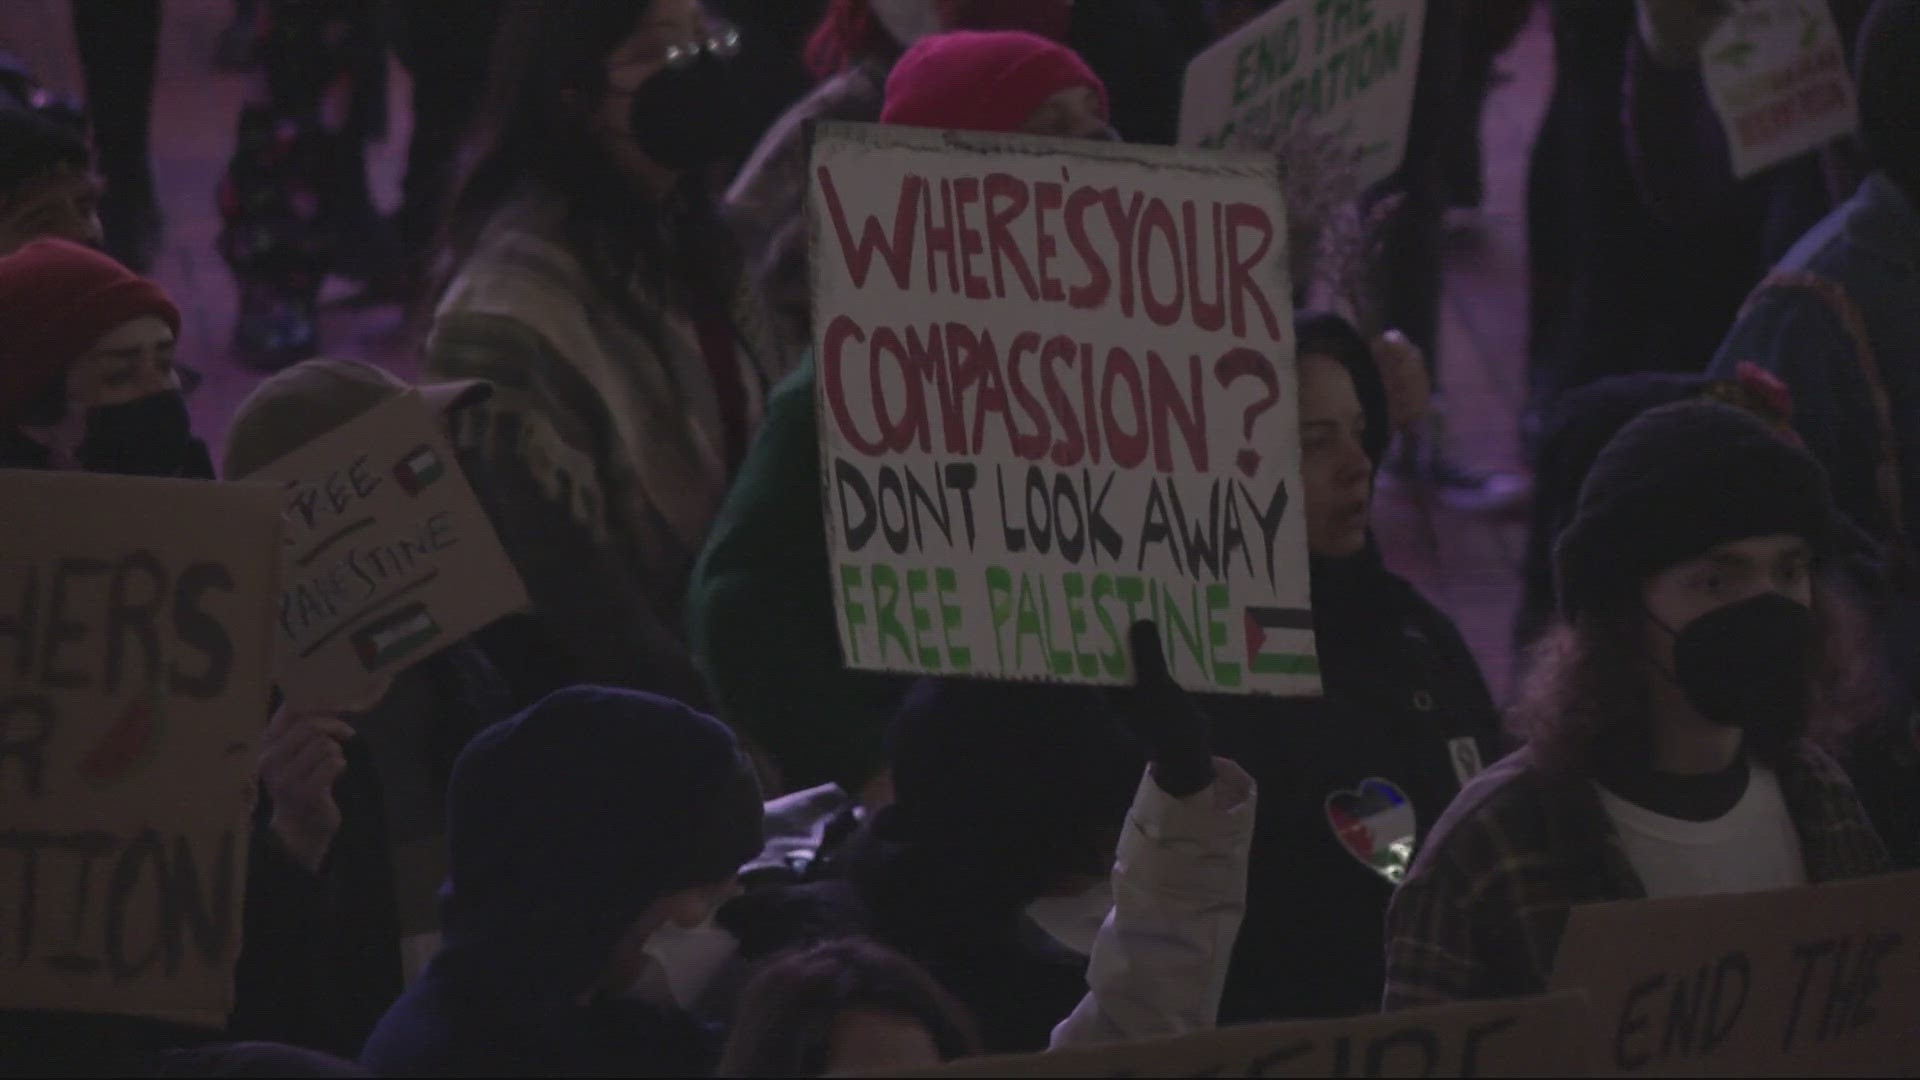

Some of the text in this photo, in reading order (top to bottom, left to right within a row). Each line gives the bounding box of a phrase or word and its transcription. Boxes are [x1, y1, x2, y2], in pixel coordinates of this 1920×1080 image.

[1232, 16, 1298, 106] END
[1101, 187, 1280, 341] YOUR
[835, 456, 1288, 597] DONT LOOK AWAY
[840, 563, 971, 669] FREE
[1614, 951, 1751, 1071] END
[1782, 932, 1901, 1054] THE
